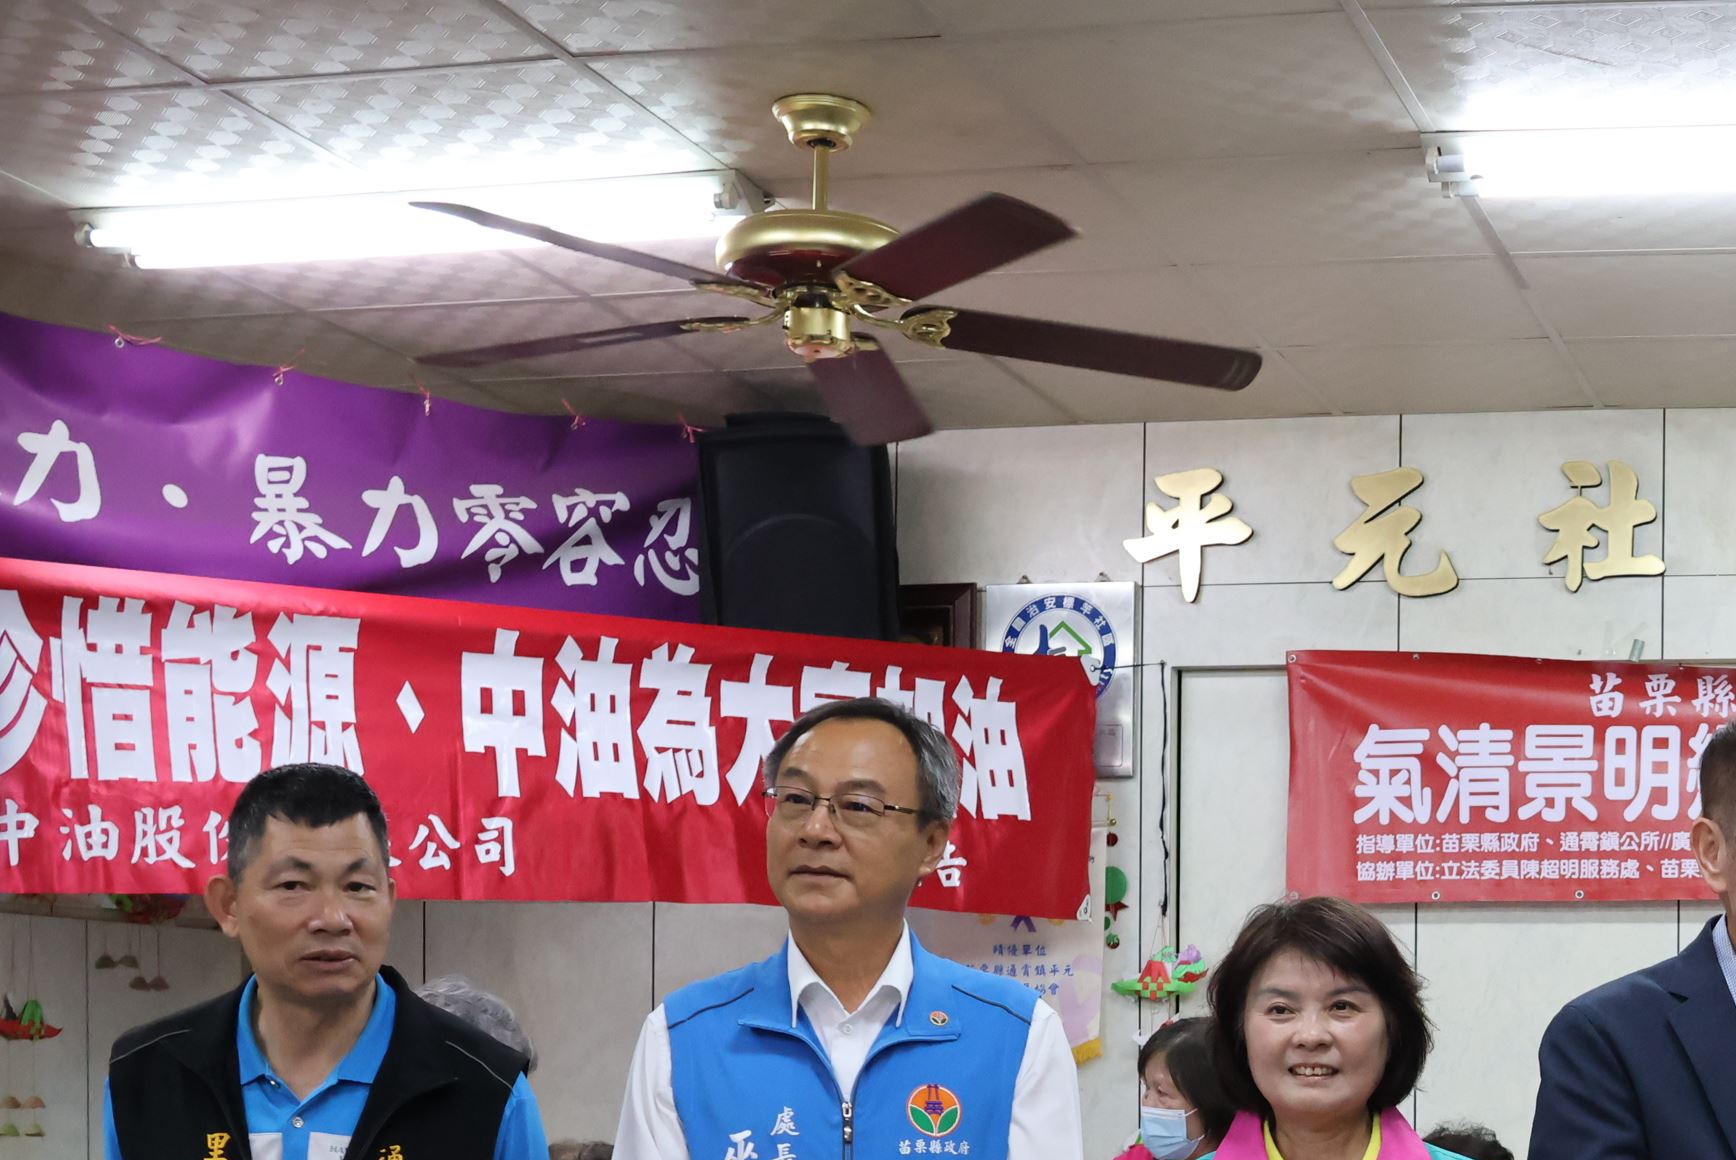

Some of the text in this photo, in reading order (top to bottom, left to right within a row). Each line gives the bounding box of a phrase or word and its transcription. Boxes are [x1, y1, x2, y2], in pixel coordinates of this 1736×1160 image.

[920, 839, 968, 888] 告
[898, 1138, 971, 1156] 苗栗縣政府
